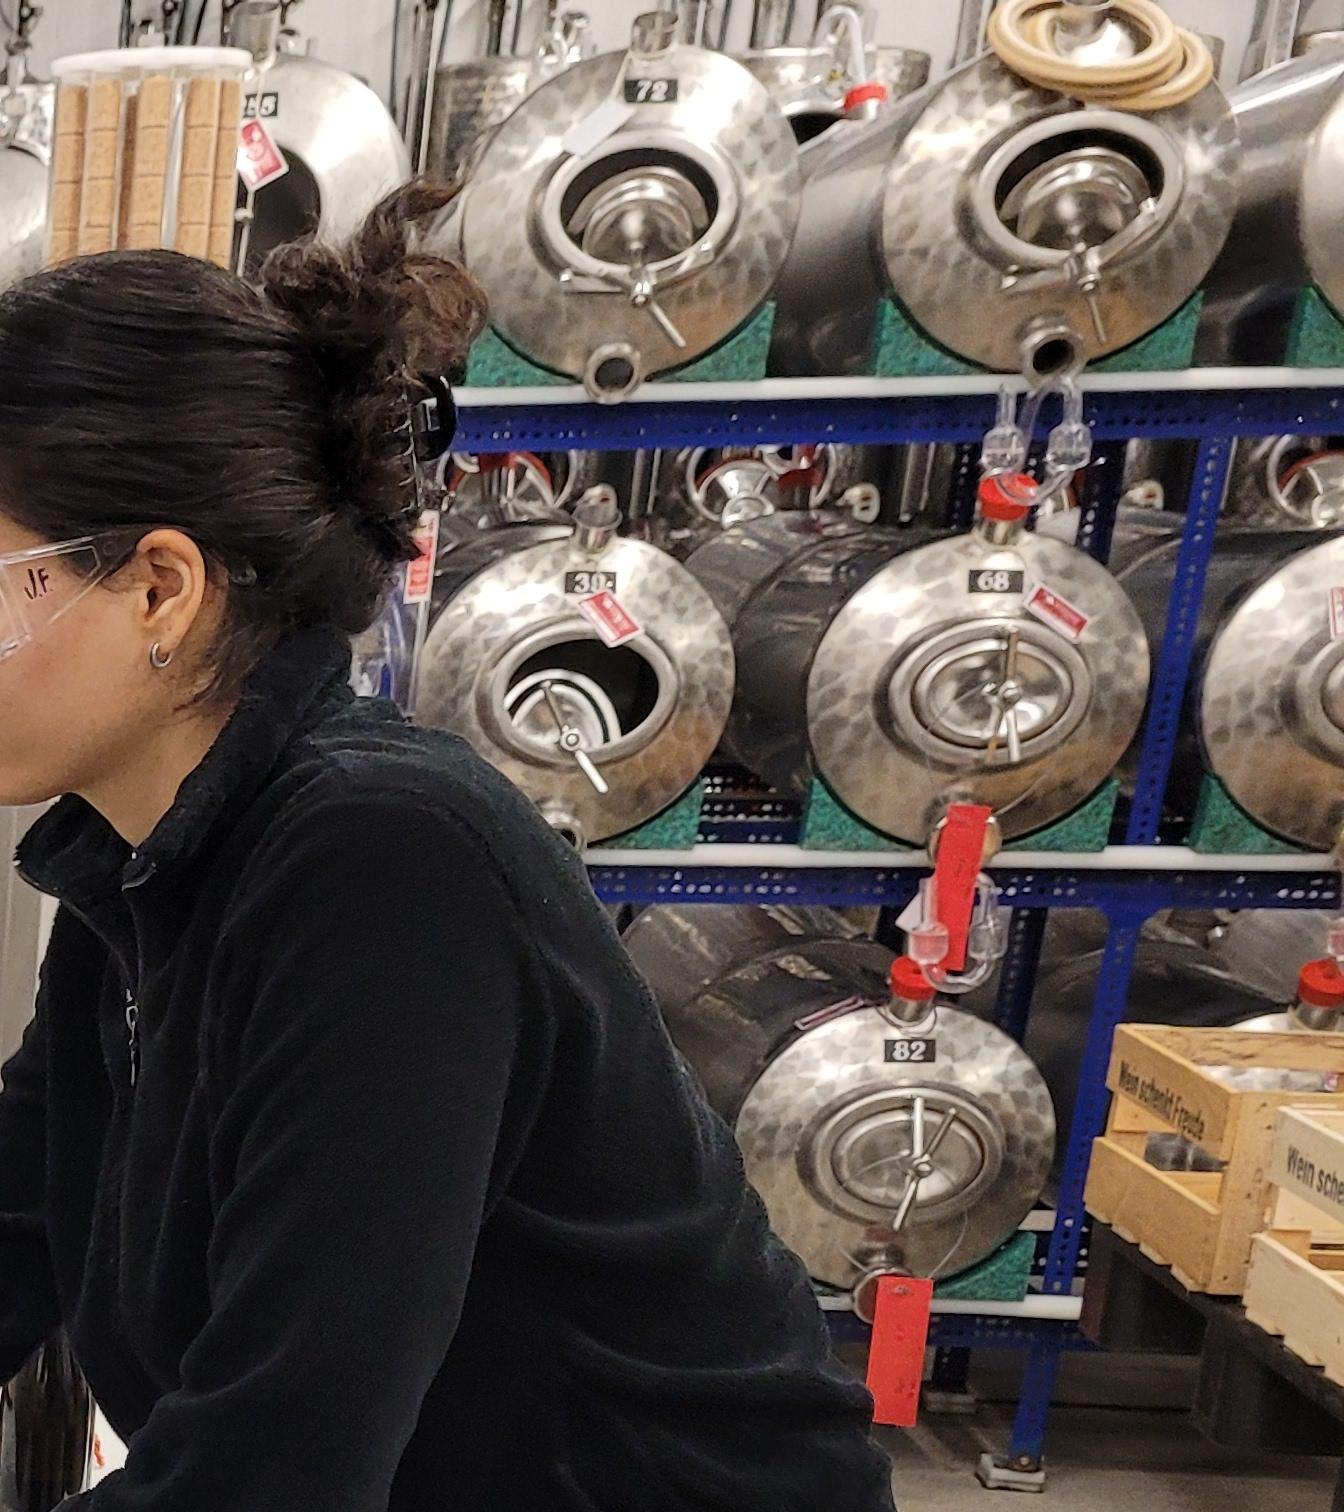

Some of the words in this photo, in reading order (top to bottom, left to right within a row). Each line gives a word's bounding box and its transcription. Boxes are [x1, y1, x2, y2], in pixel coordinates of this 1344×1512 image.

[636, 79, 669, 102] 72
[977, 570, 1011, 592] 68
[892, 1040, 927, 1061] 82
[1118, 1061, 1140, 1096] Wein
[1286, 1143, 1315, 1190] Wein
